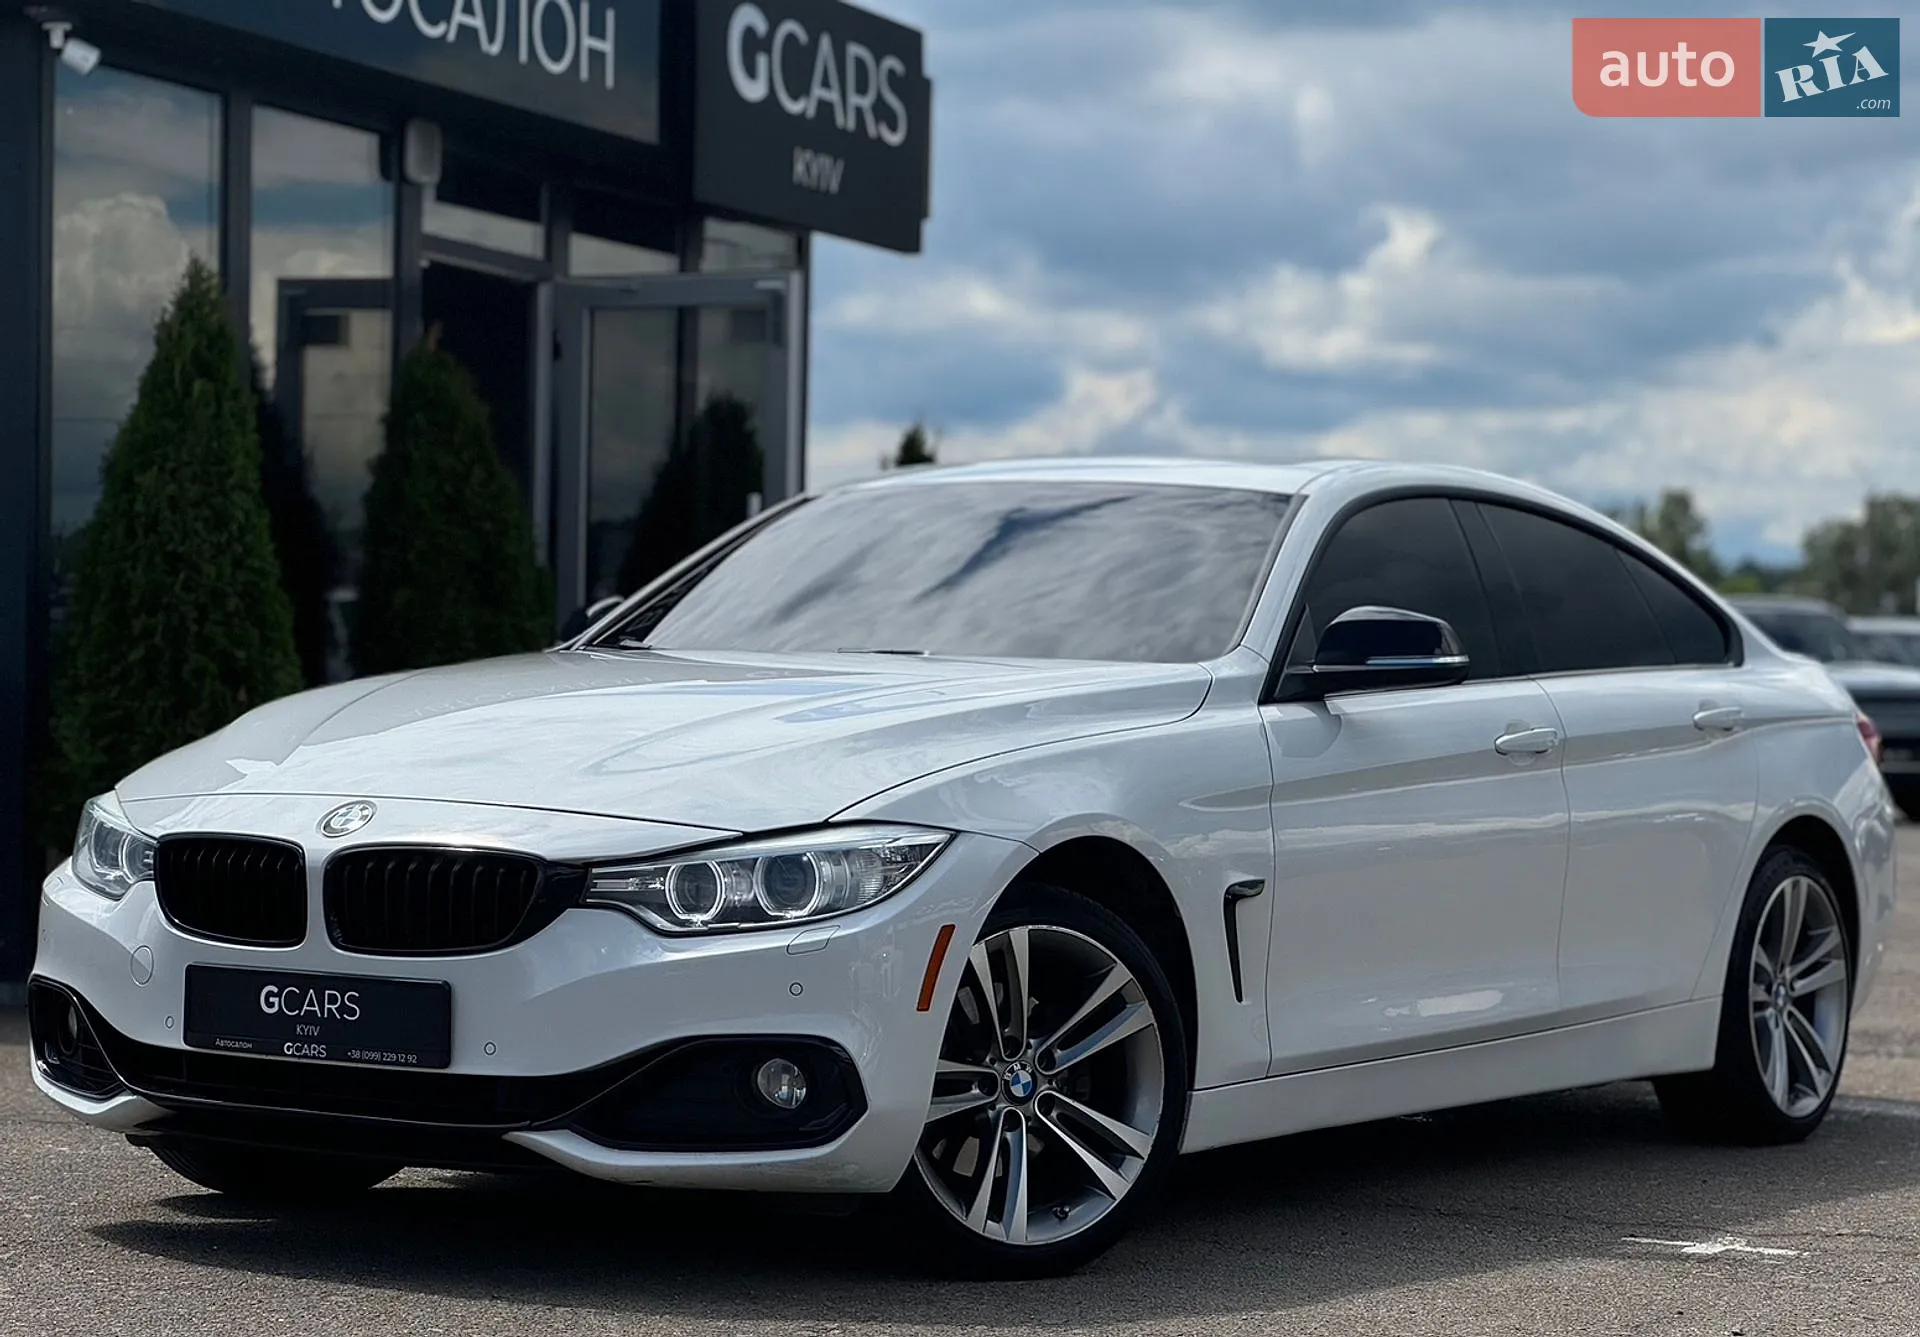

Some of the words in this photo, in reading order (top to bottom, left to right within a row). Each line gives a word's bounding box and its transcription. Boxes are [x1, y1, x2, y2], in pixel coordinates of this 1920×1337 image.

[332, 0, 616, 90] АЛОН
[726, 2, 909, 147] GCARS
[792, 146, 845, 195] KYIV
[260, 985, 360, 1020] GCARS
[296, 1024, 321, 1036] KYIV
[215, 1038, 253, 1049] Автосалон
[283, 1042, 327, 1058] GCARS
[382, 1052, 397, 1062] 229
[407, 1054, 418, 1064] 92
